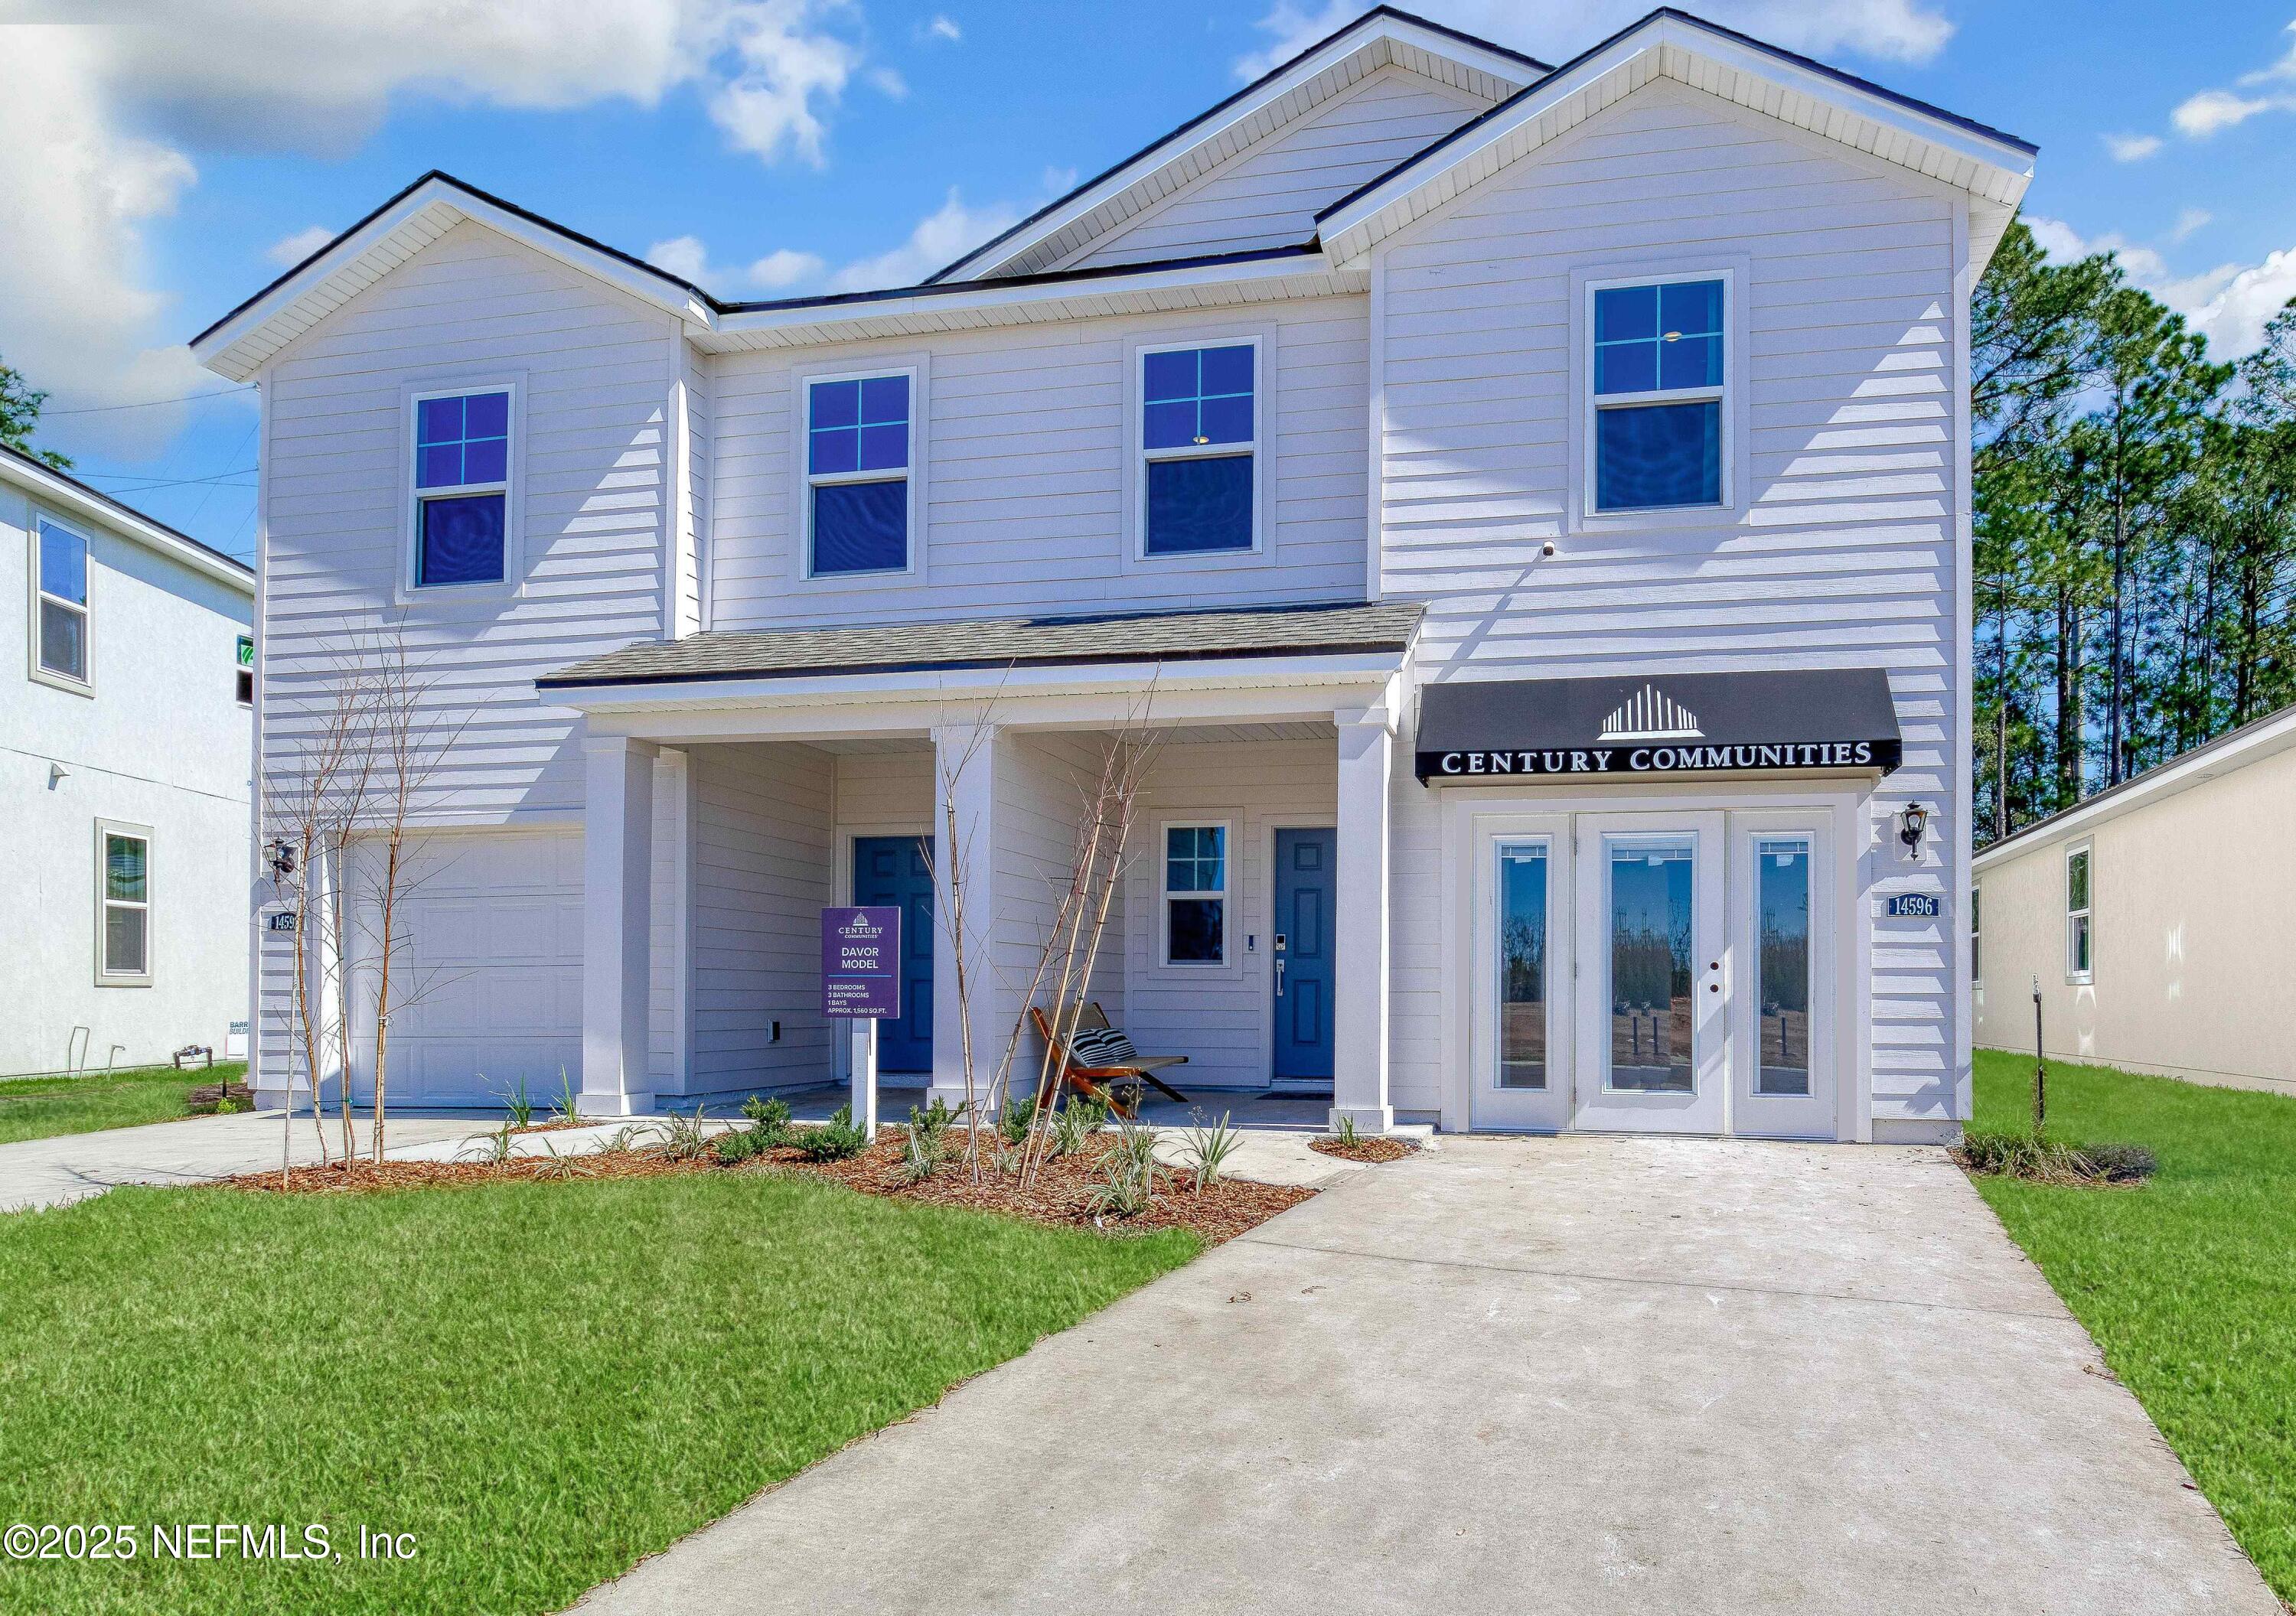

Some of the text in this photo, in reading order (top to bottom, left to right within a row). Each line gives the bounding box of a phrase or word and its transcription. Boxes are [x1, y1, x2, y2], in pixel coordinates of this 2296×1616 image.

[1442, 742, 1871, 773] CENTURY COMMUNITIES
[1895, 897, 1932, 915] 14596
[276, 915, 295, 929] 1459
[842, 947, 879, 956] DAVOR
[842, 960, 879, 969] MODEL
